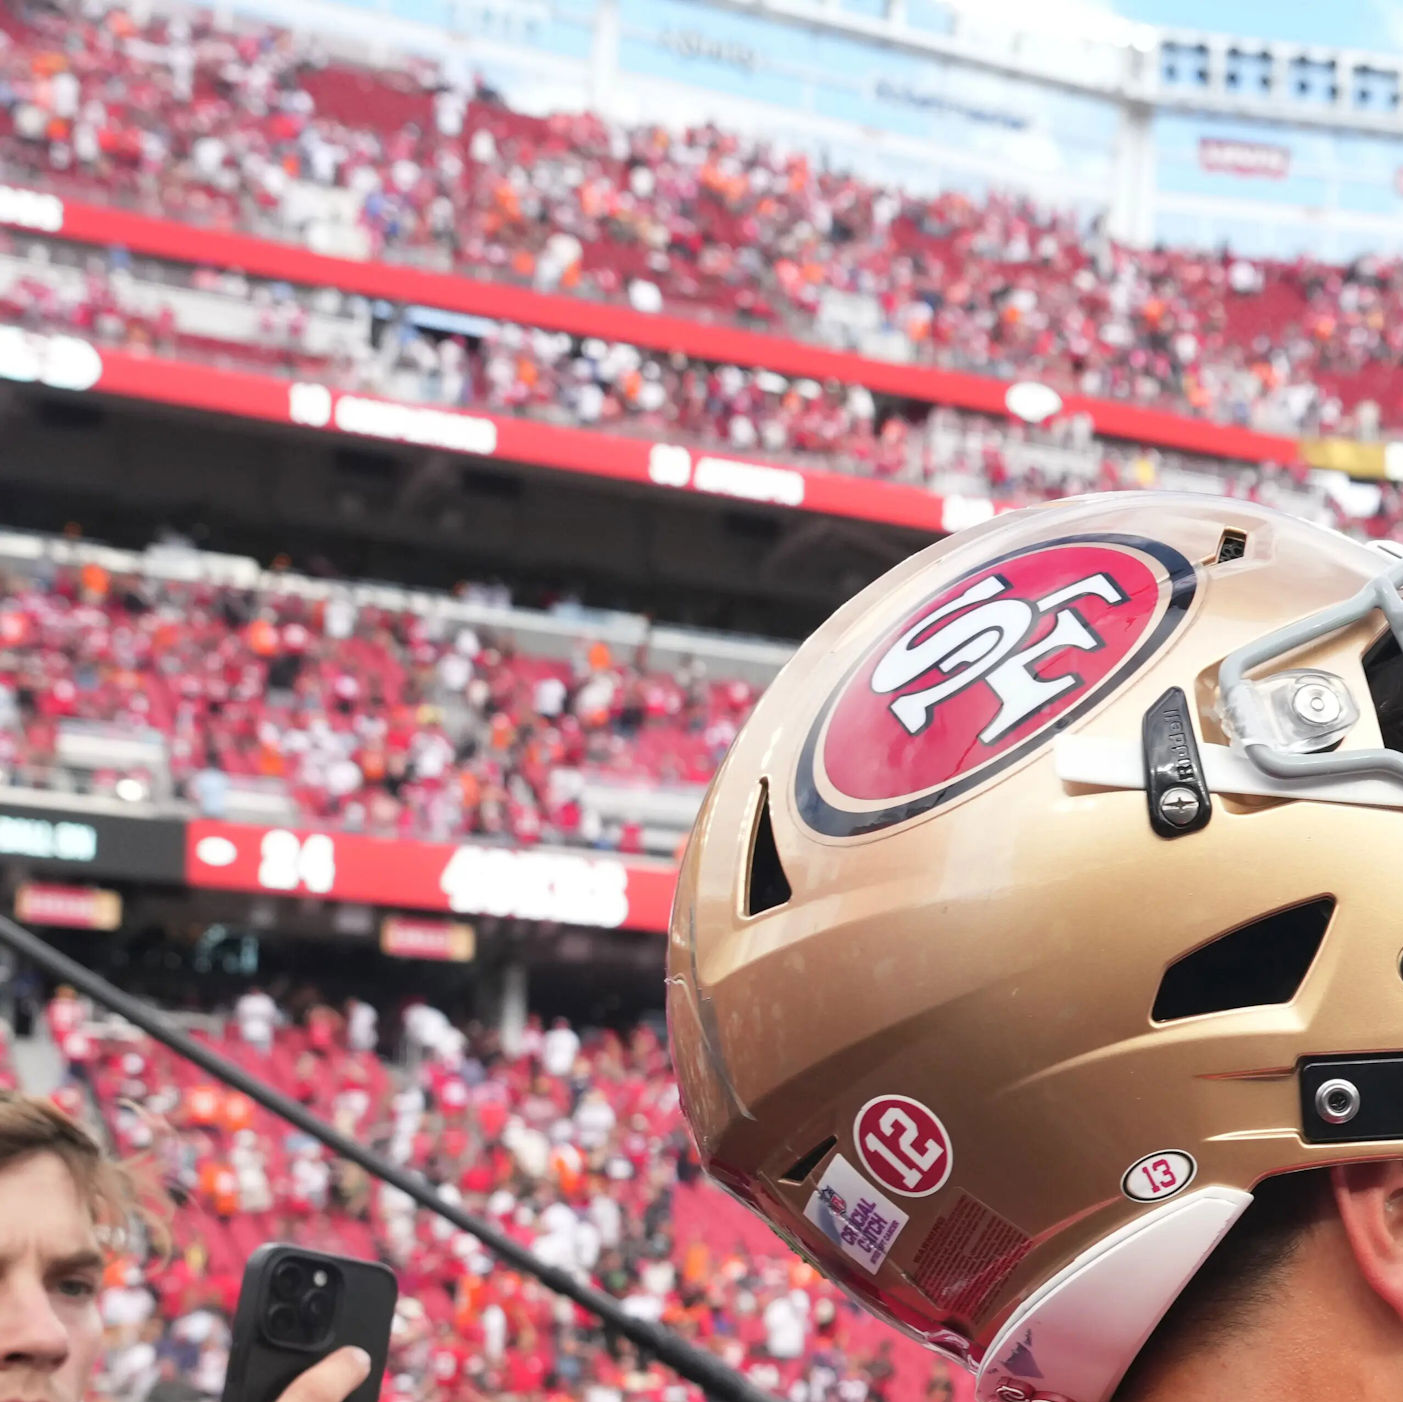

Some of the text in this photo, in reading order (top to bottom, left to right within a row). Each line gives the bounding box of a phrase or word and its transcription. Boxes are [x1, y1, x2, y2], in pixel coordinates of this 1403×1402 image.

[870, 571, 1130, 747] SF
[1163, 709, 1195, 782] Riddell
[865, 1107, 944, 1189] 12
[1142, 1159, 1176, 1193] 13
[841, 1198, 876, 1246] CRUCIAL
[857, 1212, 888, 1253] CATCH
